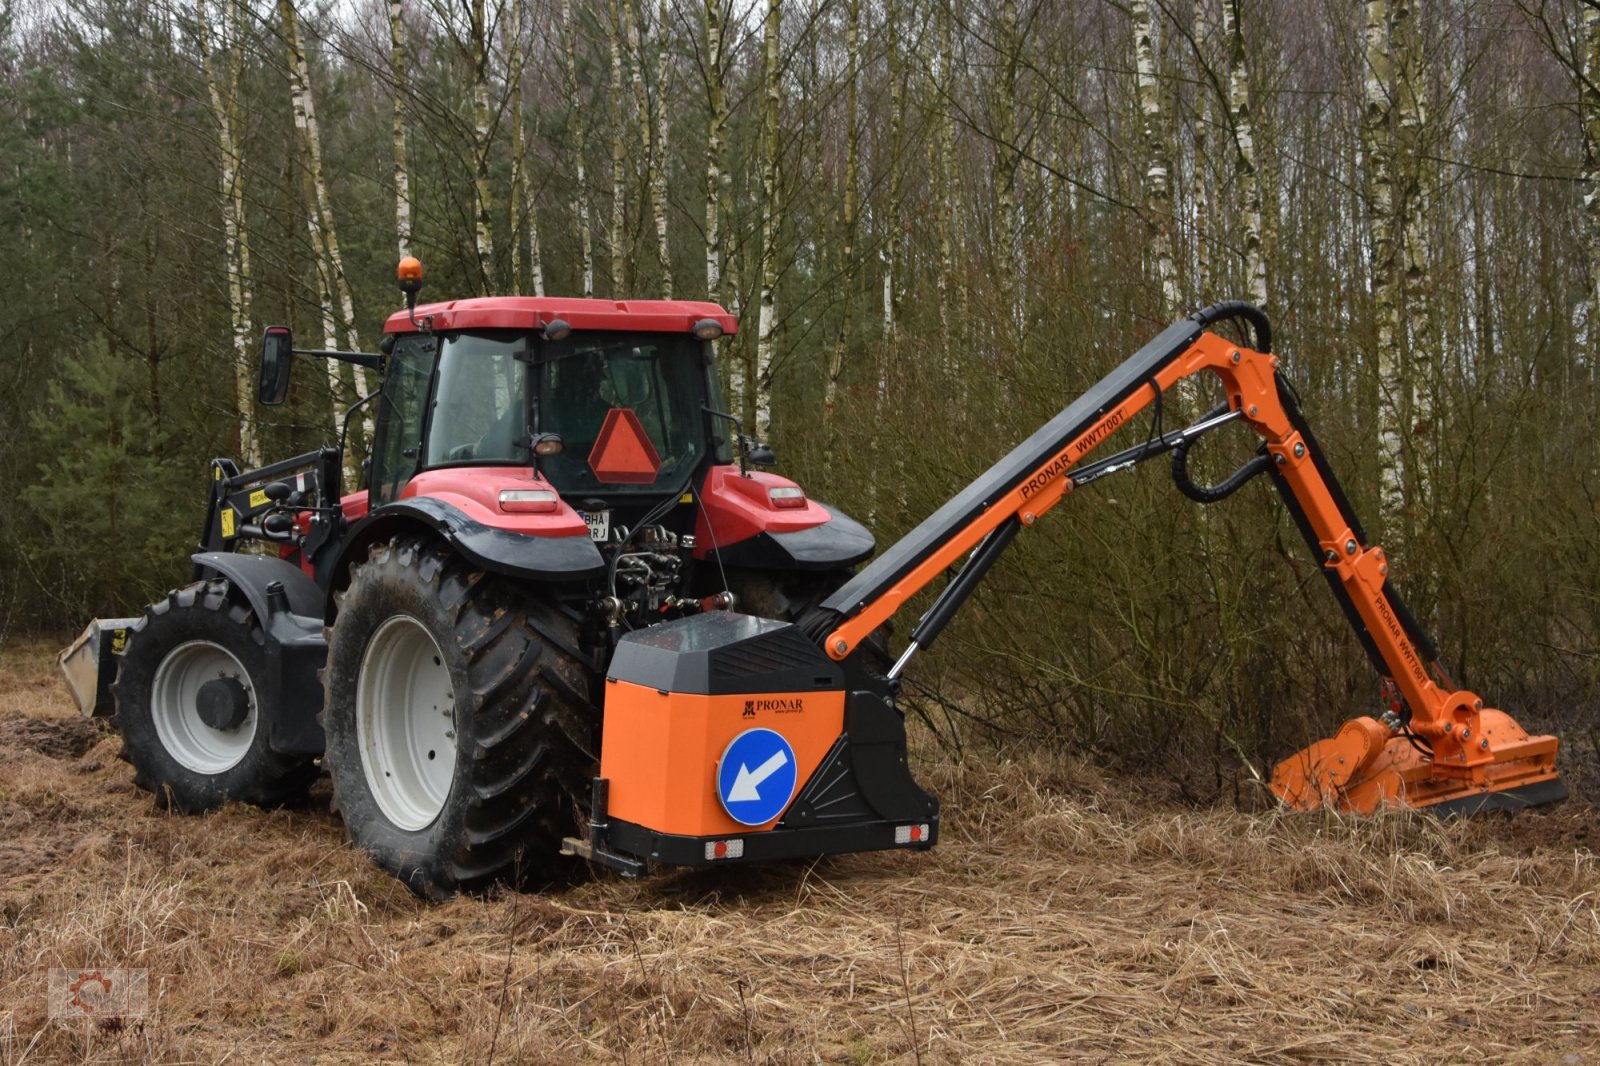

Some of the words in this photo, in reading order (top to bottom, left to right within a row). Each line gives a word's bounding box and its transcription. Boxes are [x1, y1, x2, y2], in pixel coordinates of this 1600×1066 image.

[1021, 454, 1072, 499] PRONAR
[1075, 410, 1124, 453] WWT700T
[584, 514, 605, 526] BHA
[1375, 596, 1401, 639] PRONAR
[1400, 639, 1428, 684] WWT700T
[756, 699, 803, 711] PRONAR
